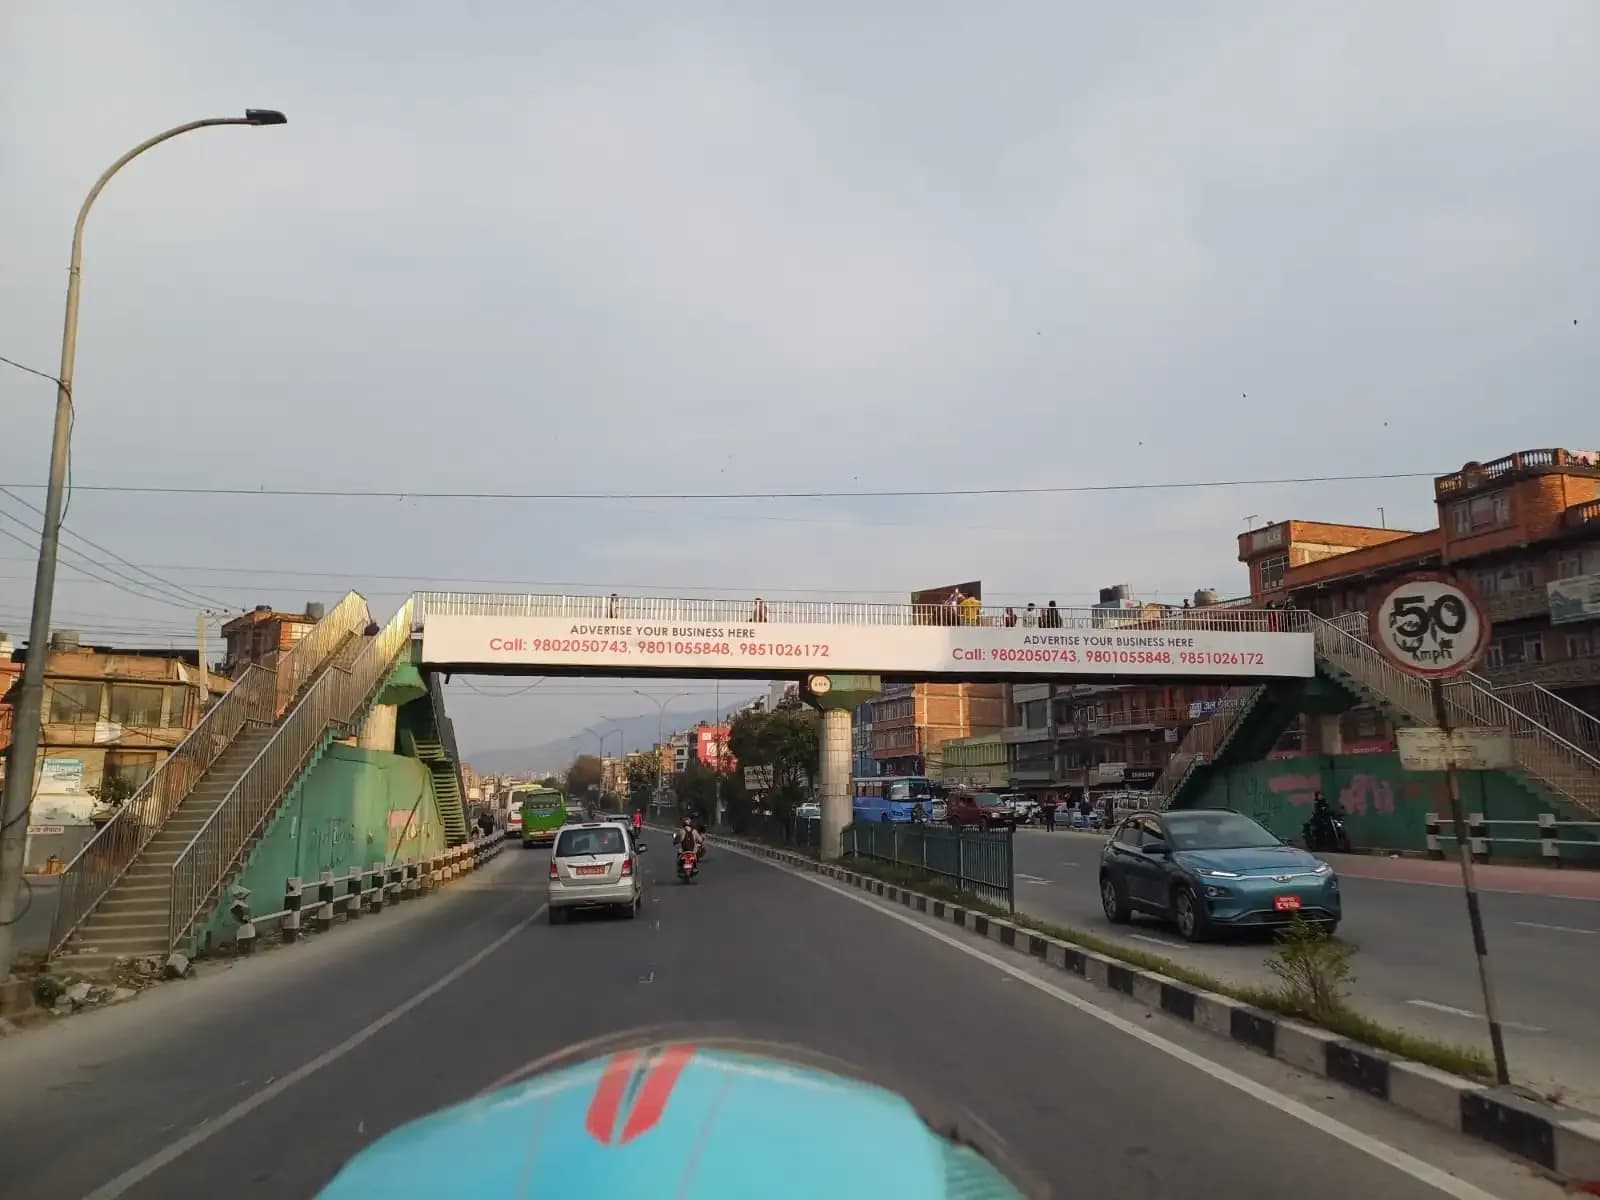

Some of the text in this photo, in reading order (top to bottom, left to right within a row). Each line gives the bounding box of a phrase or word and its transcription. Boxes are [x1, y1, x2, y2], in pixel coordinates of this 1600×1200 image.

[1393, 594, 1466, 637] 50
[570, 625, 755, 639] ADVERTISE YOUR BUSINESS HERE
[489, 637, 830, 657] Call: 9802050743, 9801055848, 9851026172
[1023, 635, 1194, 649] ADVERTISE YOUR BUSINESS HERE
[952, 647, 1264, 665] Call: 9802050743, 9801055848, 9851026172
